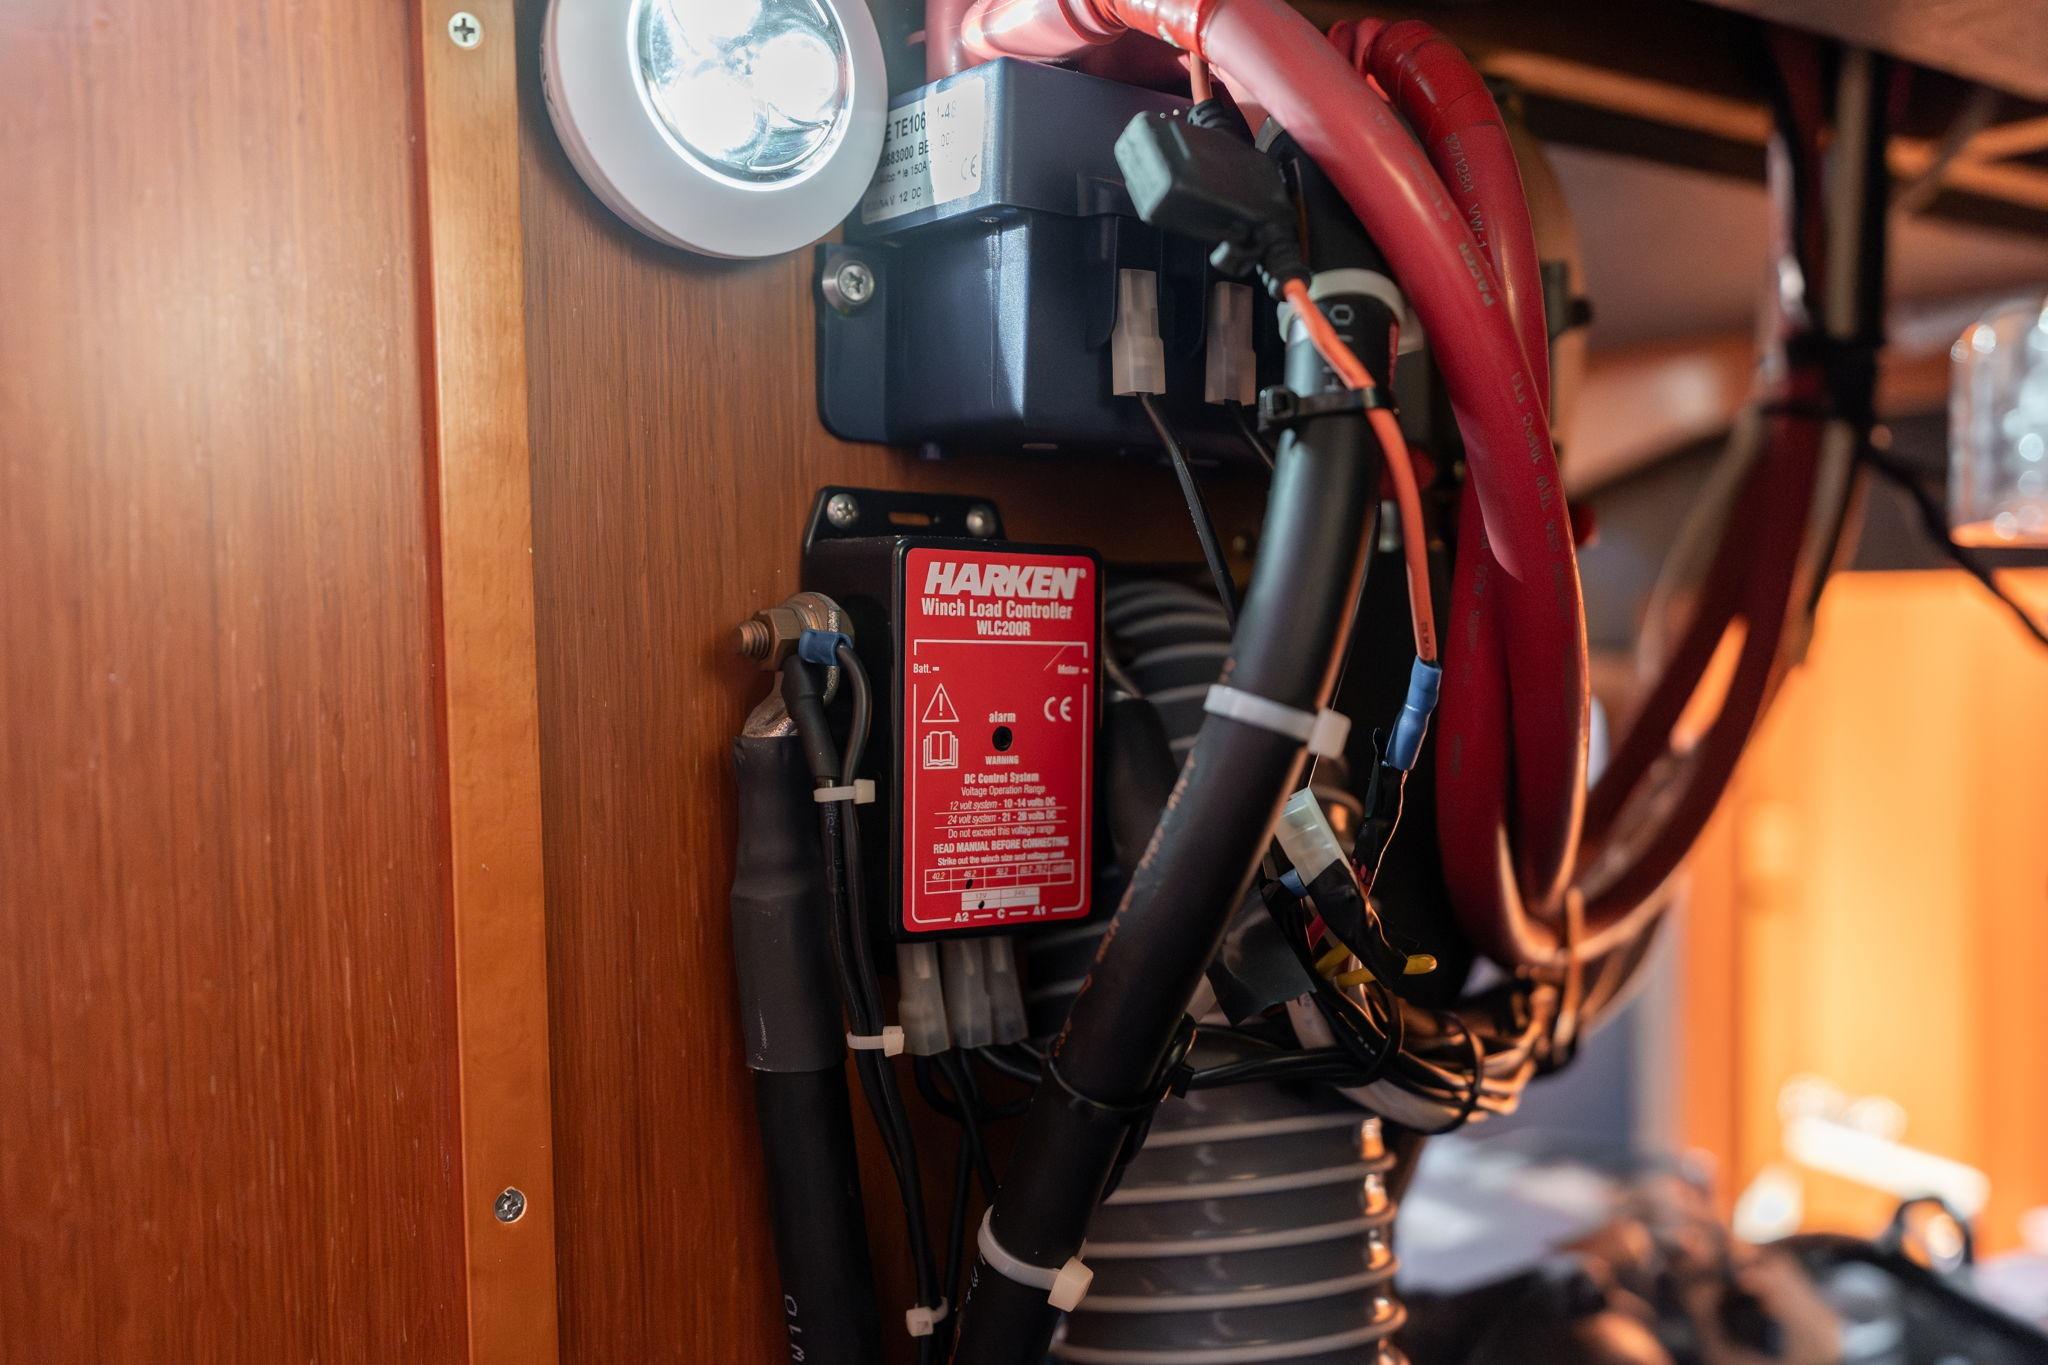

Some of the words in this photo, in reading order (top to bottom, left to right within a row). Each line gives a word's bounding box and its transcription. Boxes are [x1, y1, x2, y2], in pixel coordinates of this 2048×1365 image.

[1468, 203, 1488, 250] VW-1
[921, 598, 965, 616] Winch
[970, 599, 1001, 617] Load
[1006, 601, 1072, 619] Controller
[977, 620, 1031, 636] WLC200R
[989, 711, 1016, 723] alarm
[985, 755, 1019, 765] WARNING
[964, 774, 975, 784] DC
[978, 773, 1007, 784] Control
[1010, 772, 1039, 784] System
[961, 787, 987, 797] Voltage
[989, 786, 1022, 796] Operation
[1024, 785, 1045, 794] Range
[950, 802, 958, 810] 12
[959, 801, 971, 810] volt
[972, 801, 997, 811] system
[948, 816, 957, 825] 24
[958, 815, 970, 824] volt
[972, 814, 996, 825] system
[948, 829, 958, 838] Do
[960, 829, 970, 838] not
[972, 828, 996, 837] exceed
[998, 827, 1009, 836] this
[1011, 826, 1034, 835] voltage
[933, 843, 954, 854] READ
[957, 841, 989, 852] MANUAL
[991, 839, 1020, 850] BEFORE
[938, 857, 957, 866] Strike
[958, 857, 969, 865] out
[970, 856, 979, 864] the
[981, 854, 999, 864] winch
[997, 908, 1005, 919] C
[1033, 905, 1046, 916] A1
[954, 912, 969, 923] A2
